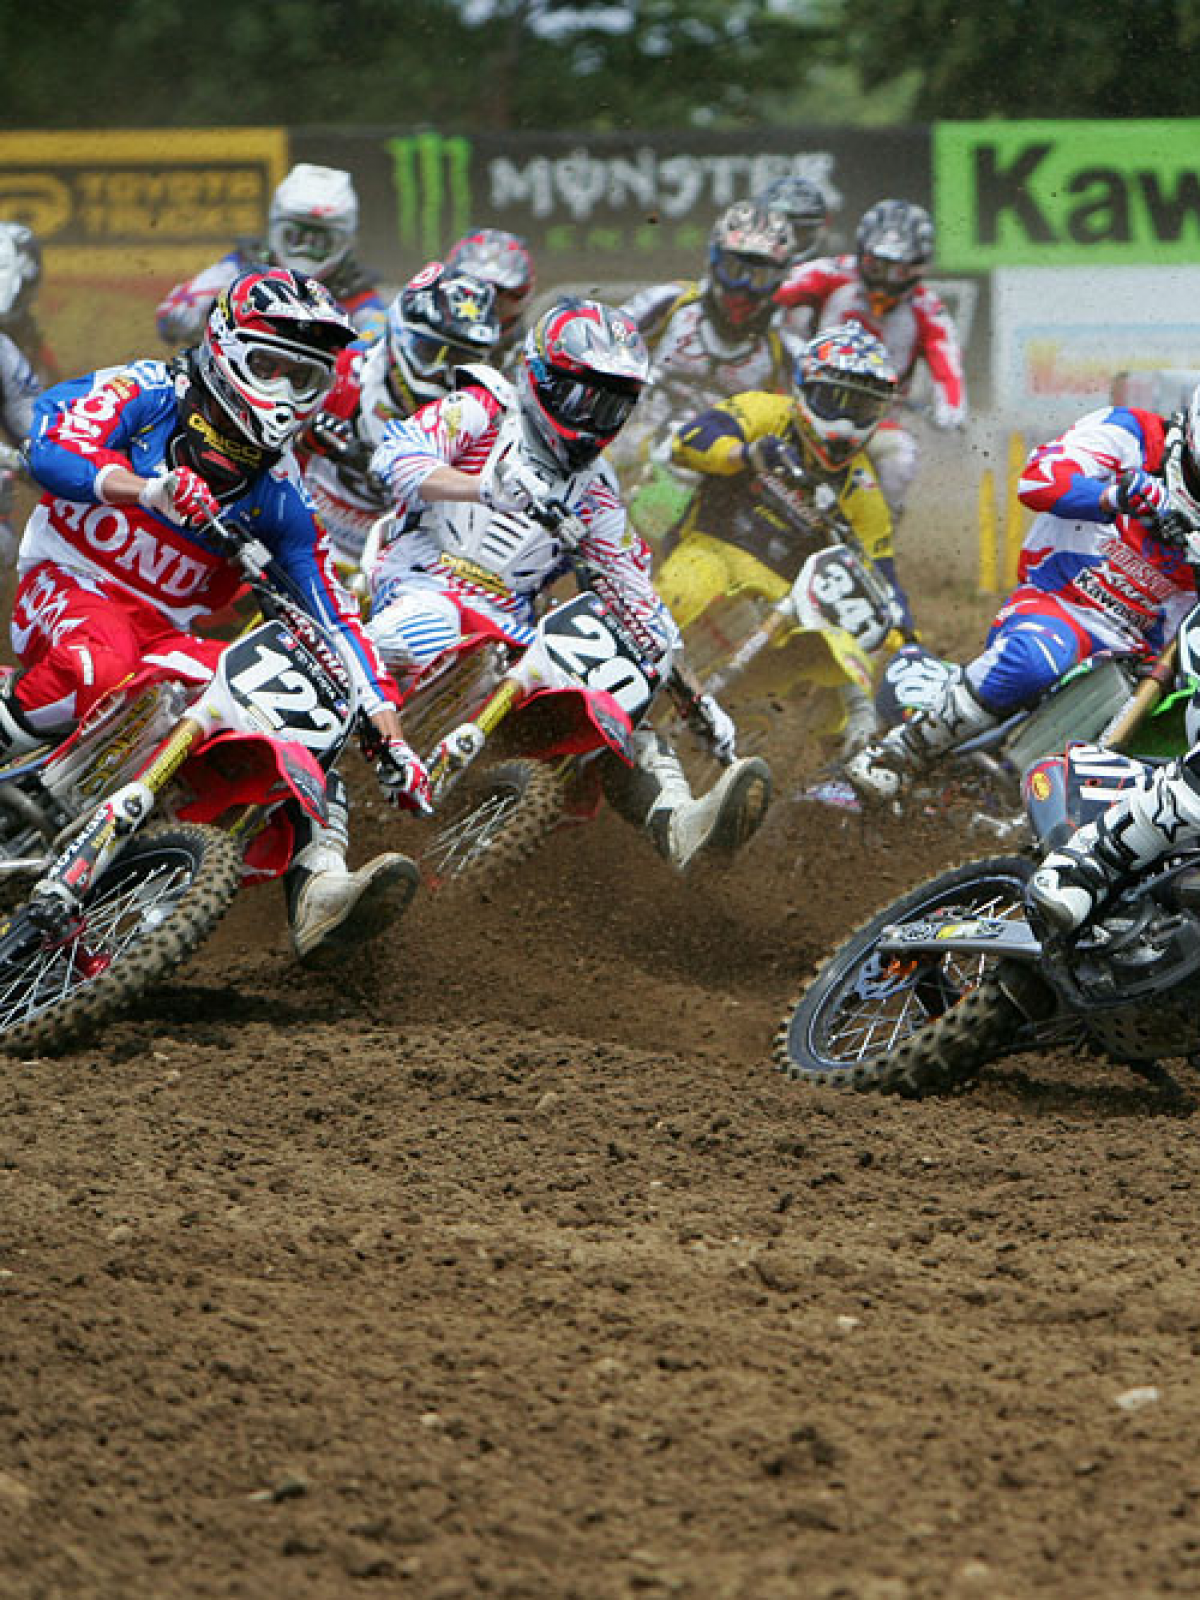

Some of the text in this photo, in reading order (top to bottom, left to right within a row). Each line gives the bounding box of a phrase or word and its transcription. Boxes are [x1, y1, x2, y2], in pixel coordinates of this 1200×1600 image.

[489, 149, 843, 219] MONSTER
[54, 499, 208, 596] HOND
[542, 614, 650, 713] 20
